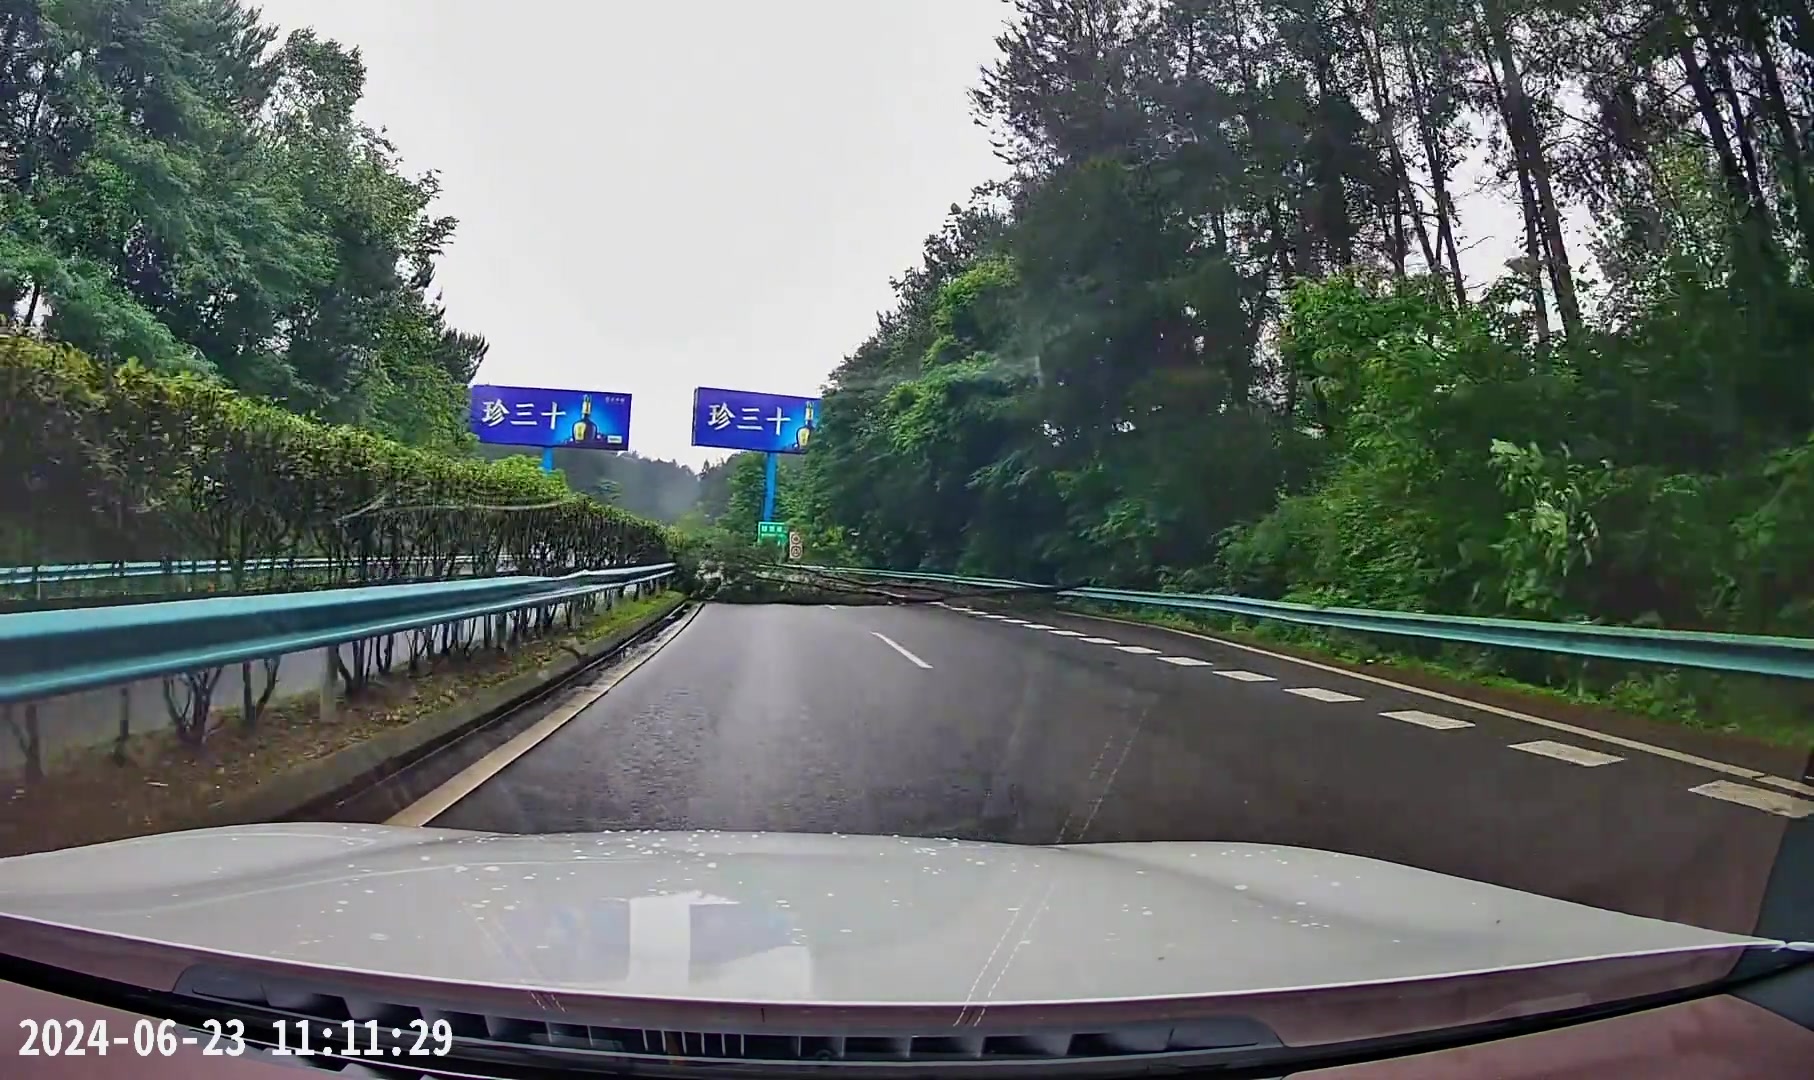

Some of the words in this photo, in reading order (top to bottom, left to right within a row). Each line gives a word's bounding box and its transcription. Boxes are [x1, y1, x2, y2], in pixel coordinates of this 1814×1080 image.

[481, 399, 566, 430] 珍三十
[707, 402, 791, 436] 珍三十
